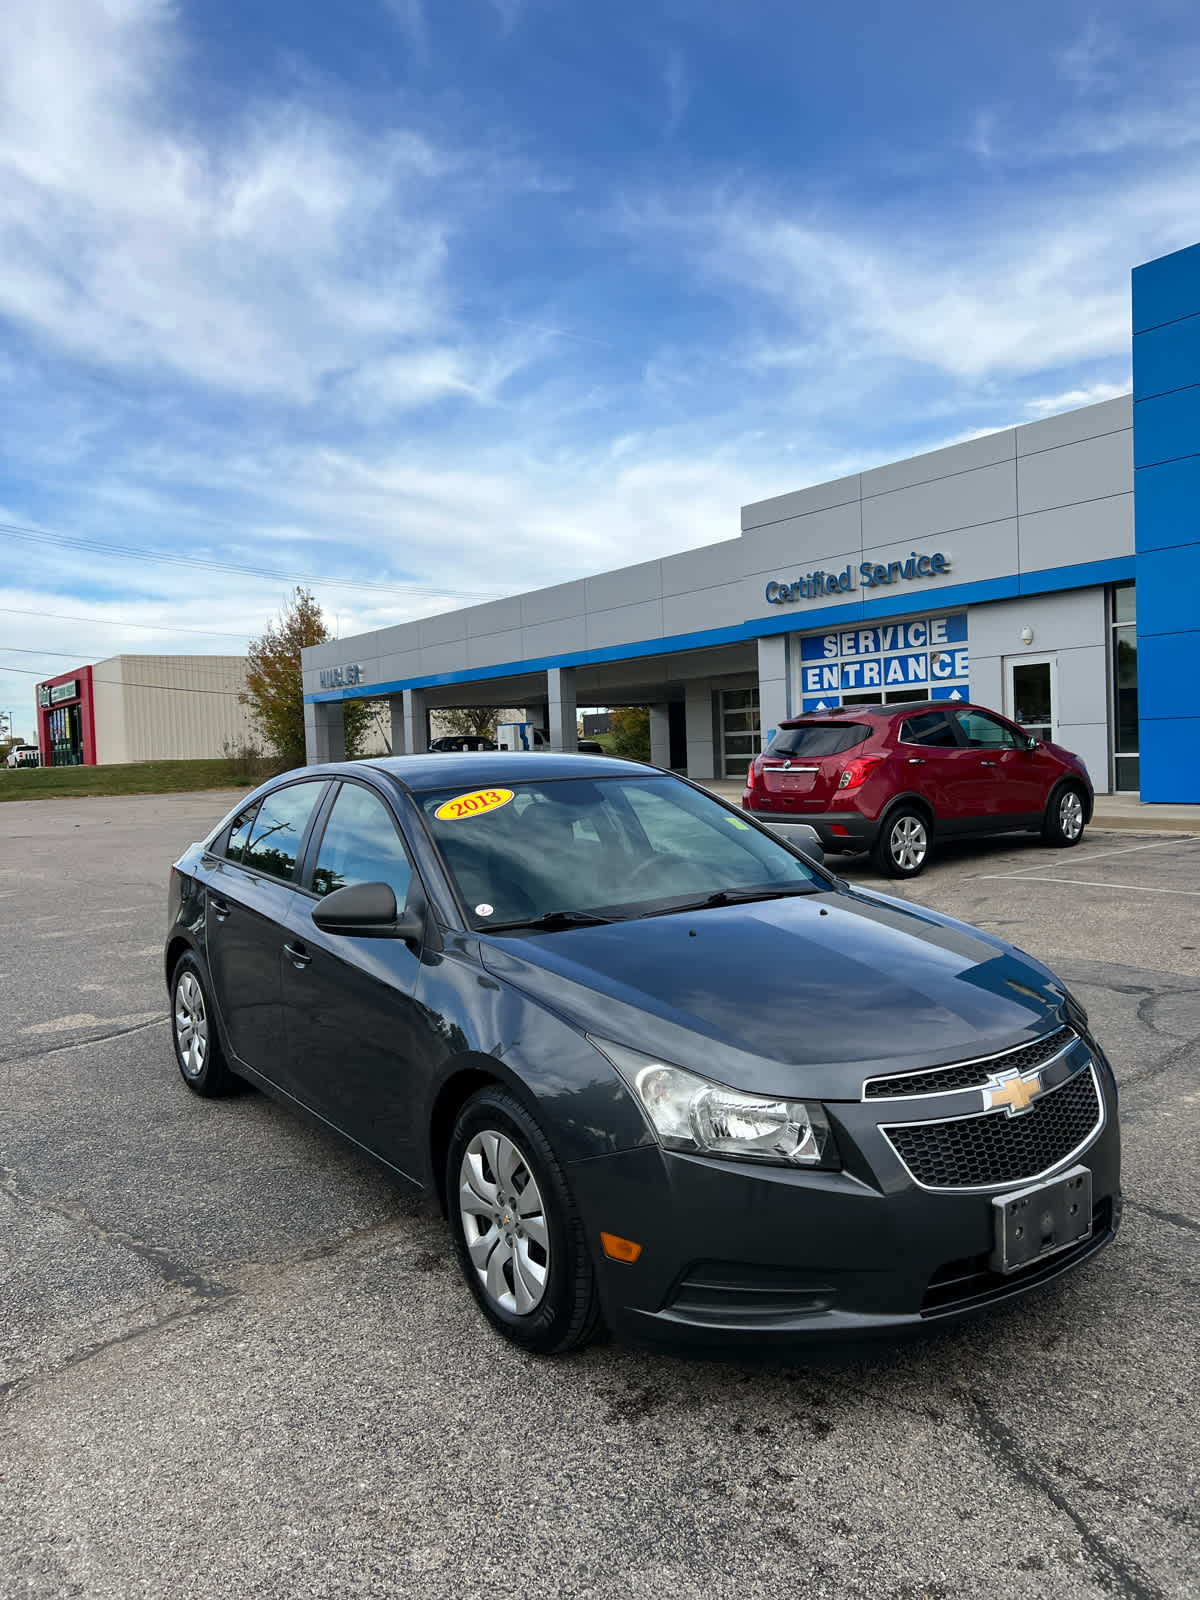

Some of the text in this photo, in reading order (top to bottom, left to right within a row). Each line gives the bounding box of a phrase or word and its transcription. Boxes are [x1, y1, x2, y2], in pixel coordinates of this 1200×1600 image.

[766, 551, 946, 604] Certified Service
[823, 618, 948, 658] SERVICE
[807, 652, 970, 691] ENTRANCE
[450, 791, 502, 817] 2013
